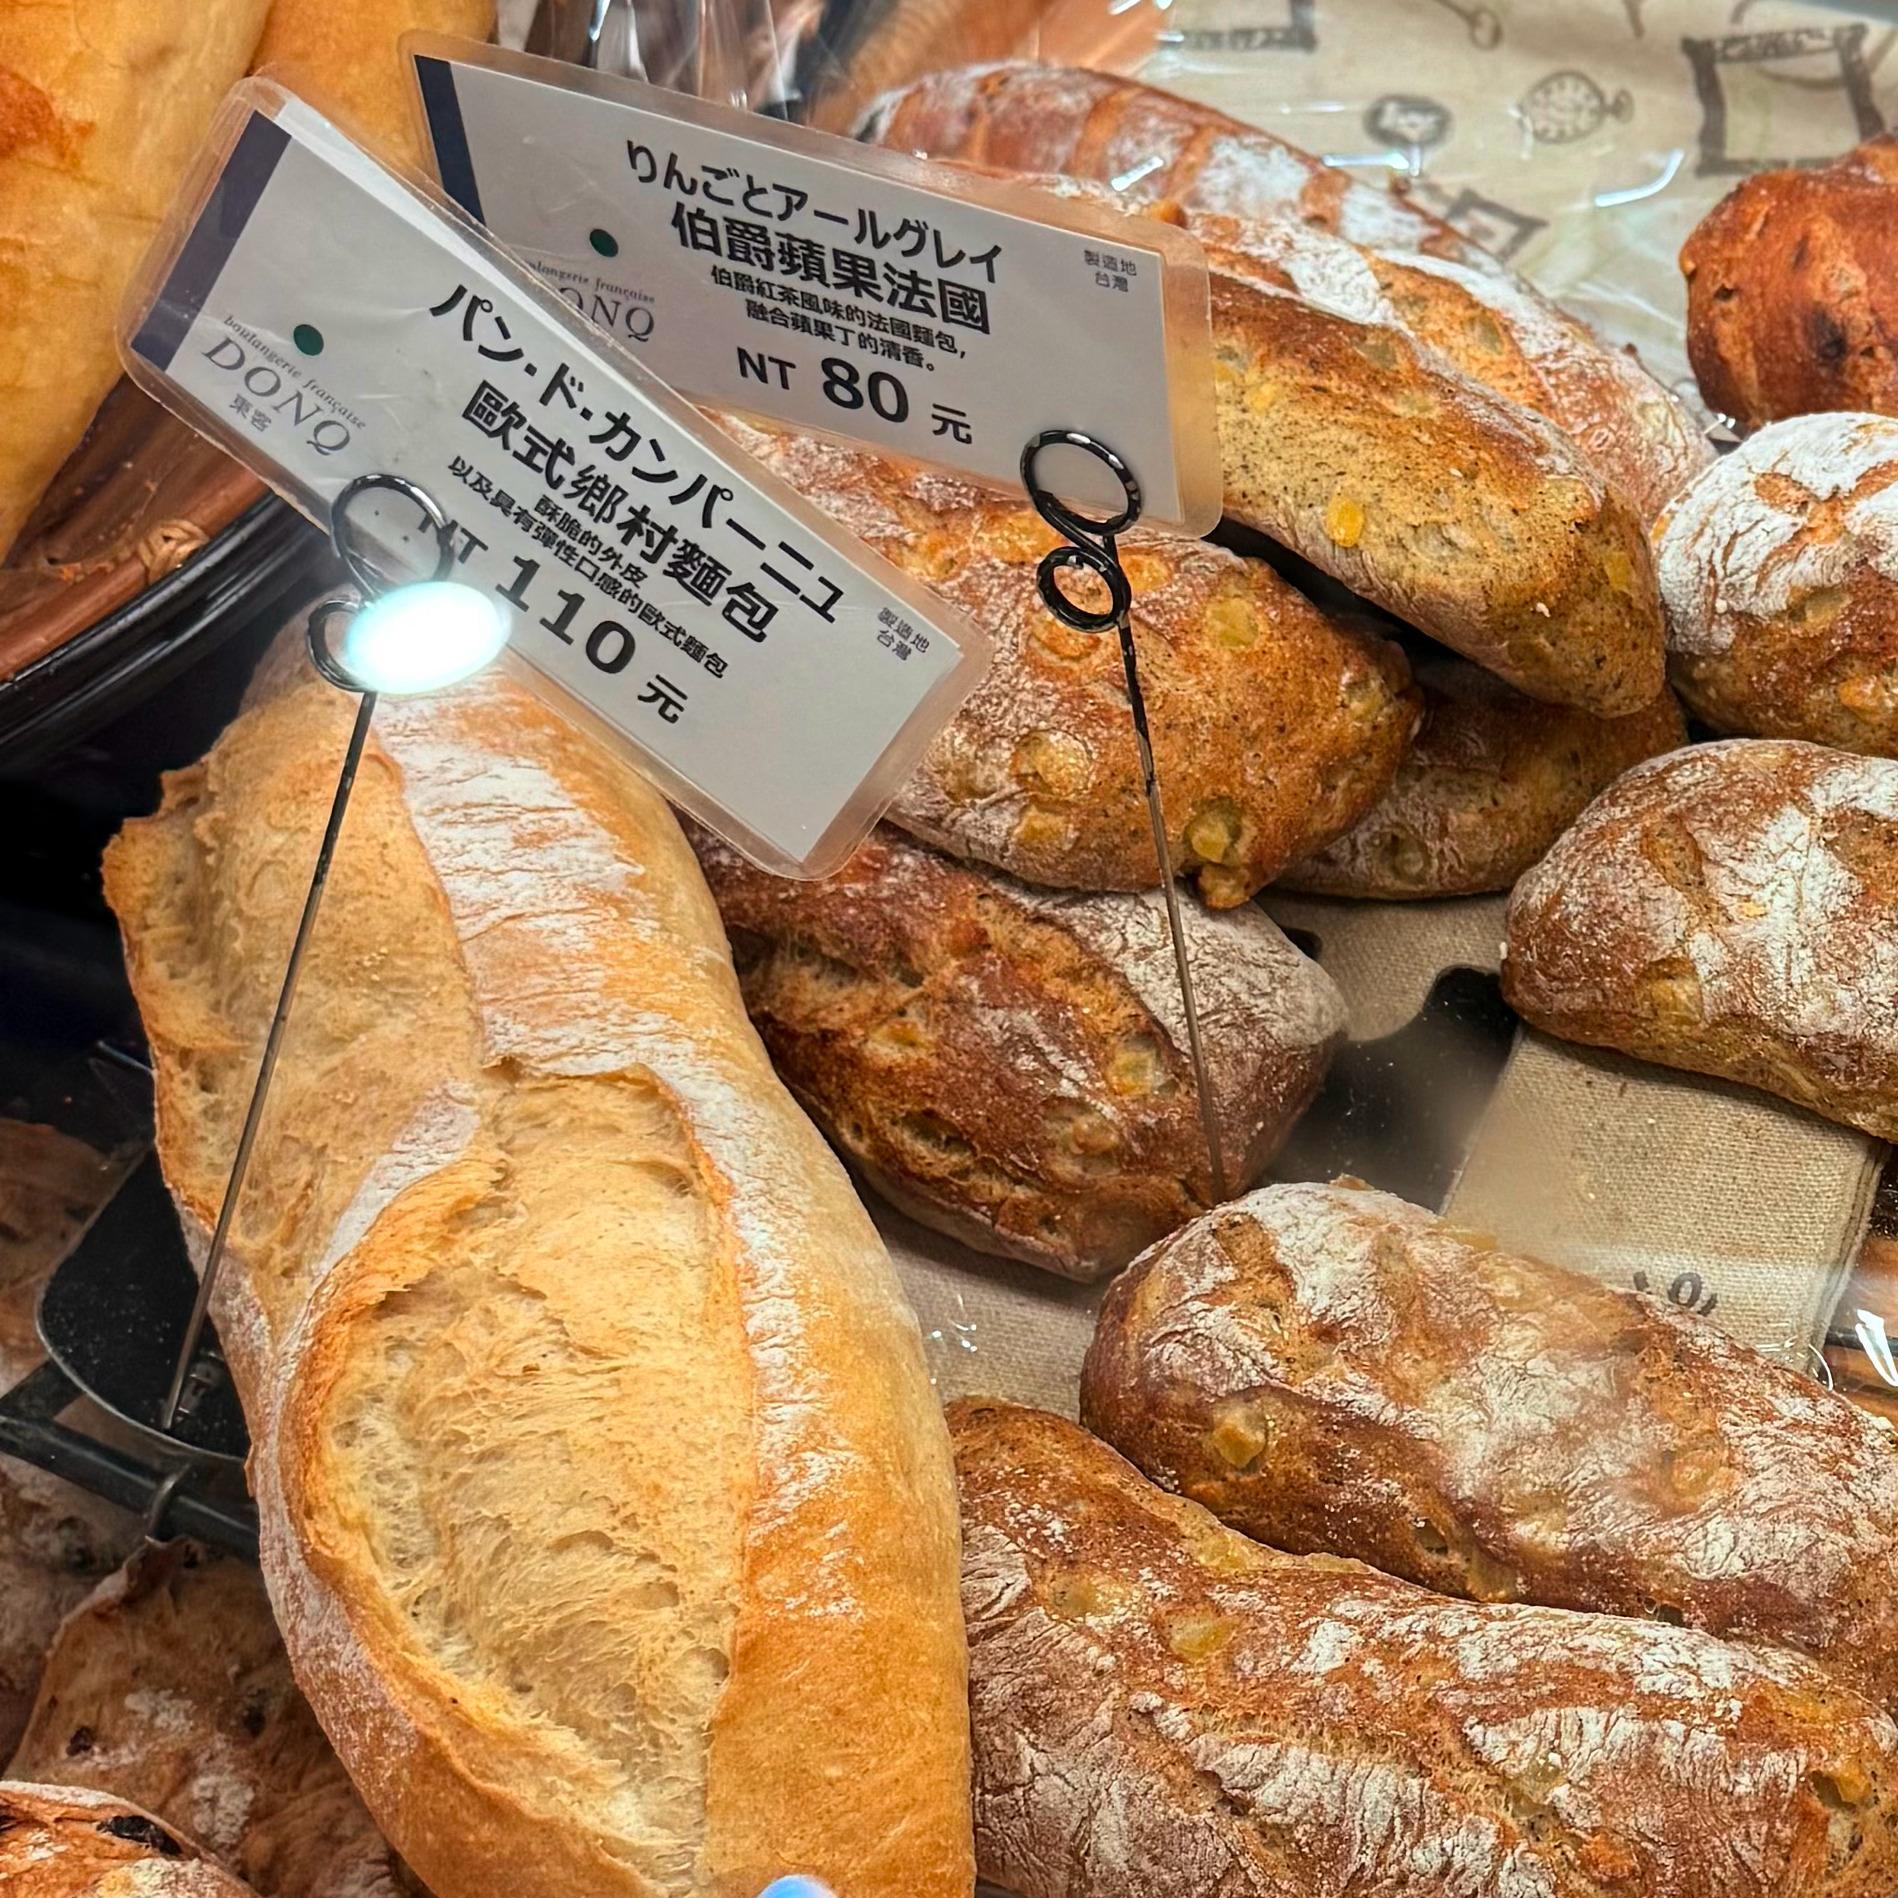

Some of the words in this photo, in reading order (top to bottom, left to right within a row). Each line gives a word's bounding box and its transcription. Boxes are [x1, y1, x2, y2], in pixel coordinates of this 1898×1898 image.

[626, 139, 1002, 284] りんごとアールグレイ
[671, 201, 991, 336] 伯爵蘋果法國
[201, 336, 351, 457] DONQ
[223, 314, 303, 378] boulangerie
[302, 378, 367, 430] française
[736, 346, 797, 391] NT
[820, 357, 910, 424] 80
[931, 402, 974, 445] 元
[429, 283, 845, 624] パン・ド・カンパーニュ
[461, 379, 779, 643] 歐式鄉村麵包
[447, 455, 729, 679] 以及具有彈性口感的歐式麵包
[533, 493, 649, 590] 酥脆的外皮
[494, 555, 637, 675] 110
[636, 673, 689, 725] 元
[877, 606, 931, 654] 製造地
